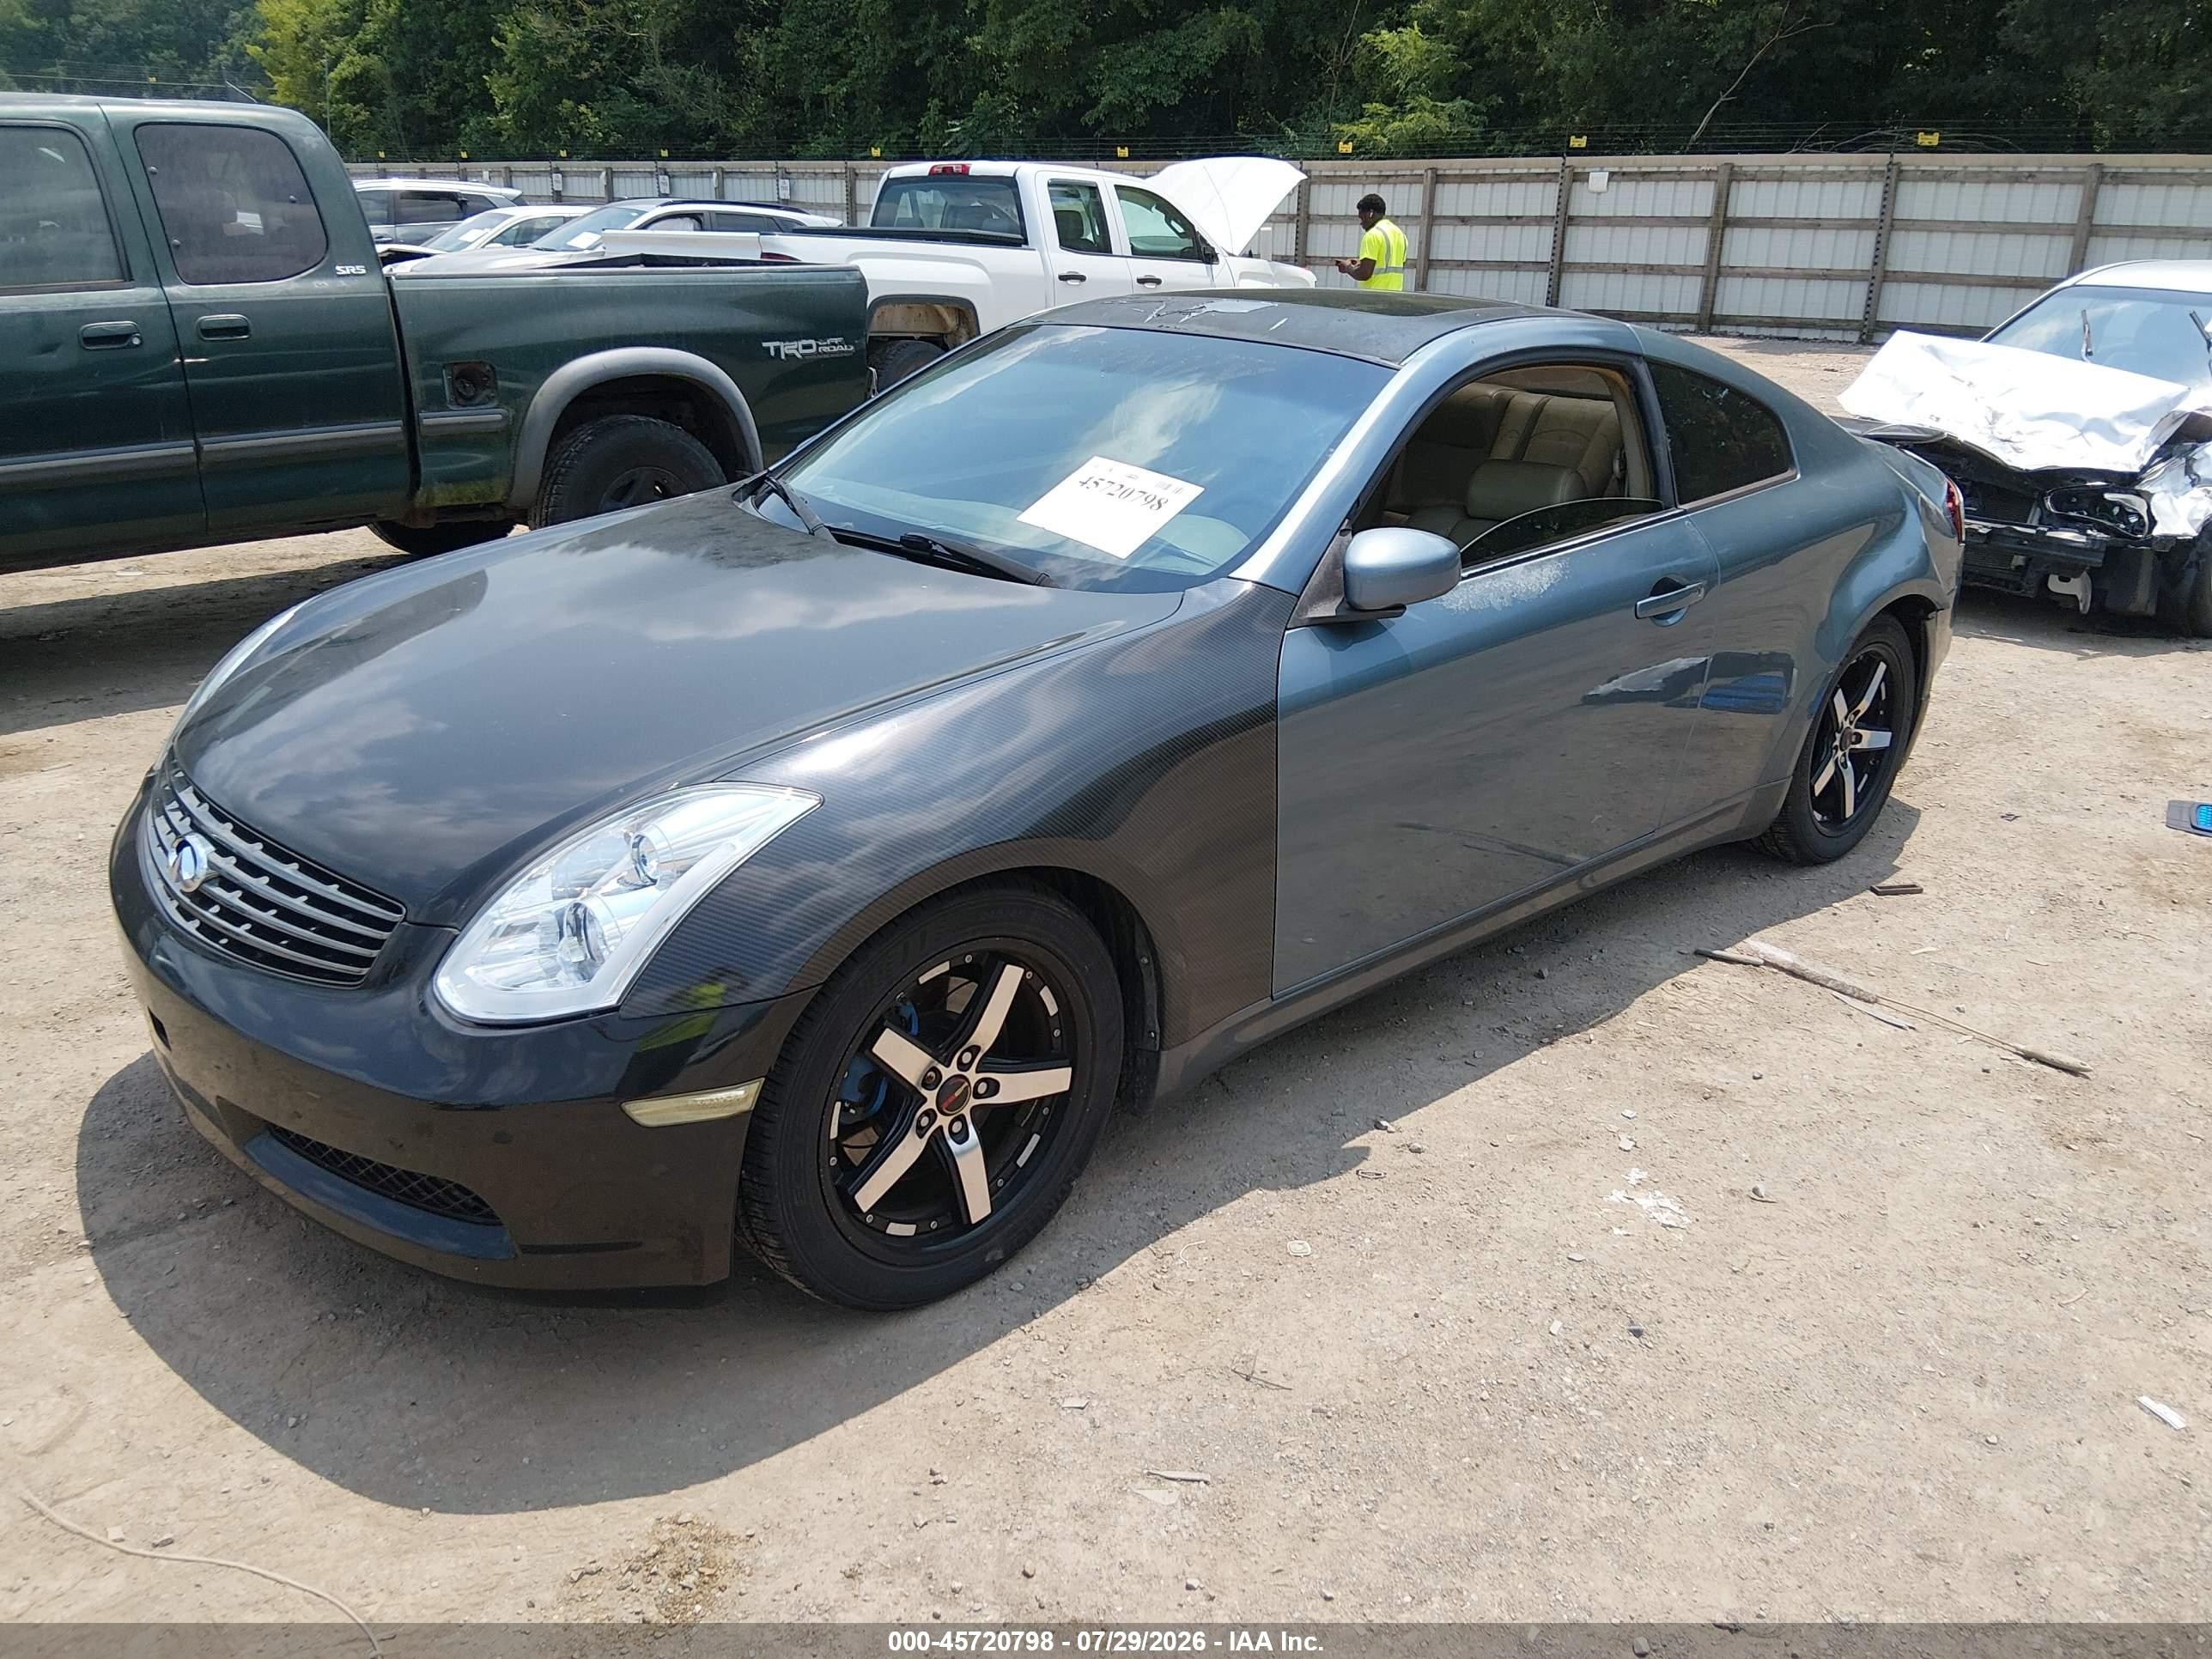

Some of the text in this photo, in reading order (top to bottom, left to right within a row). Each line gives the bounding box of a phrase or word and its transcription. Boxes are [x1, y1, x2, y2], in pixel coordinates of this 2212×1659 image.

[336, 265, 367, 275] SR5
[762, 339, 817, 360] TRD
[1079, 476, 1169, 511] 45720798
